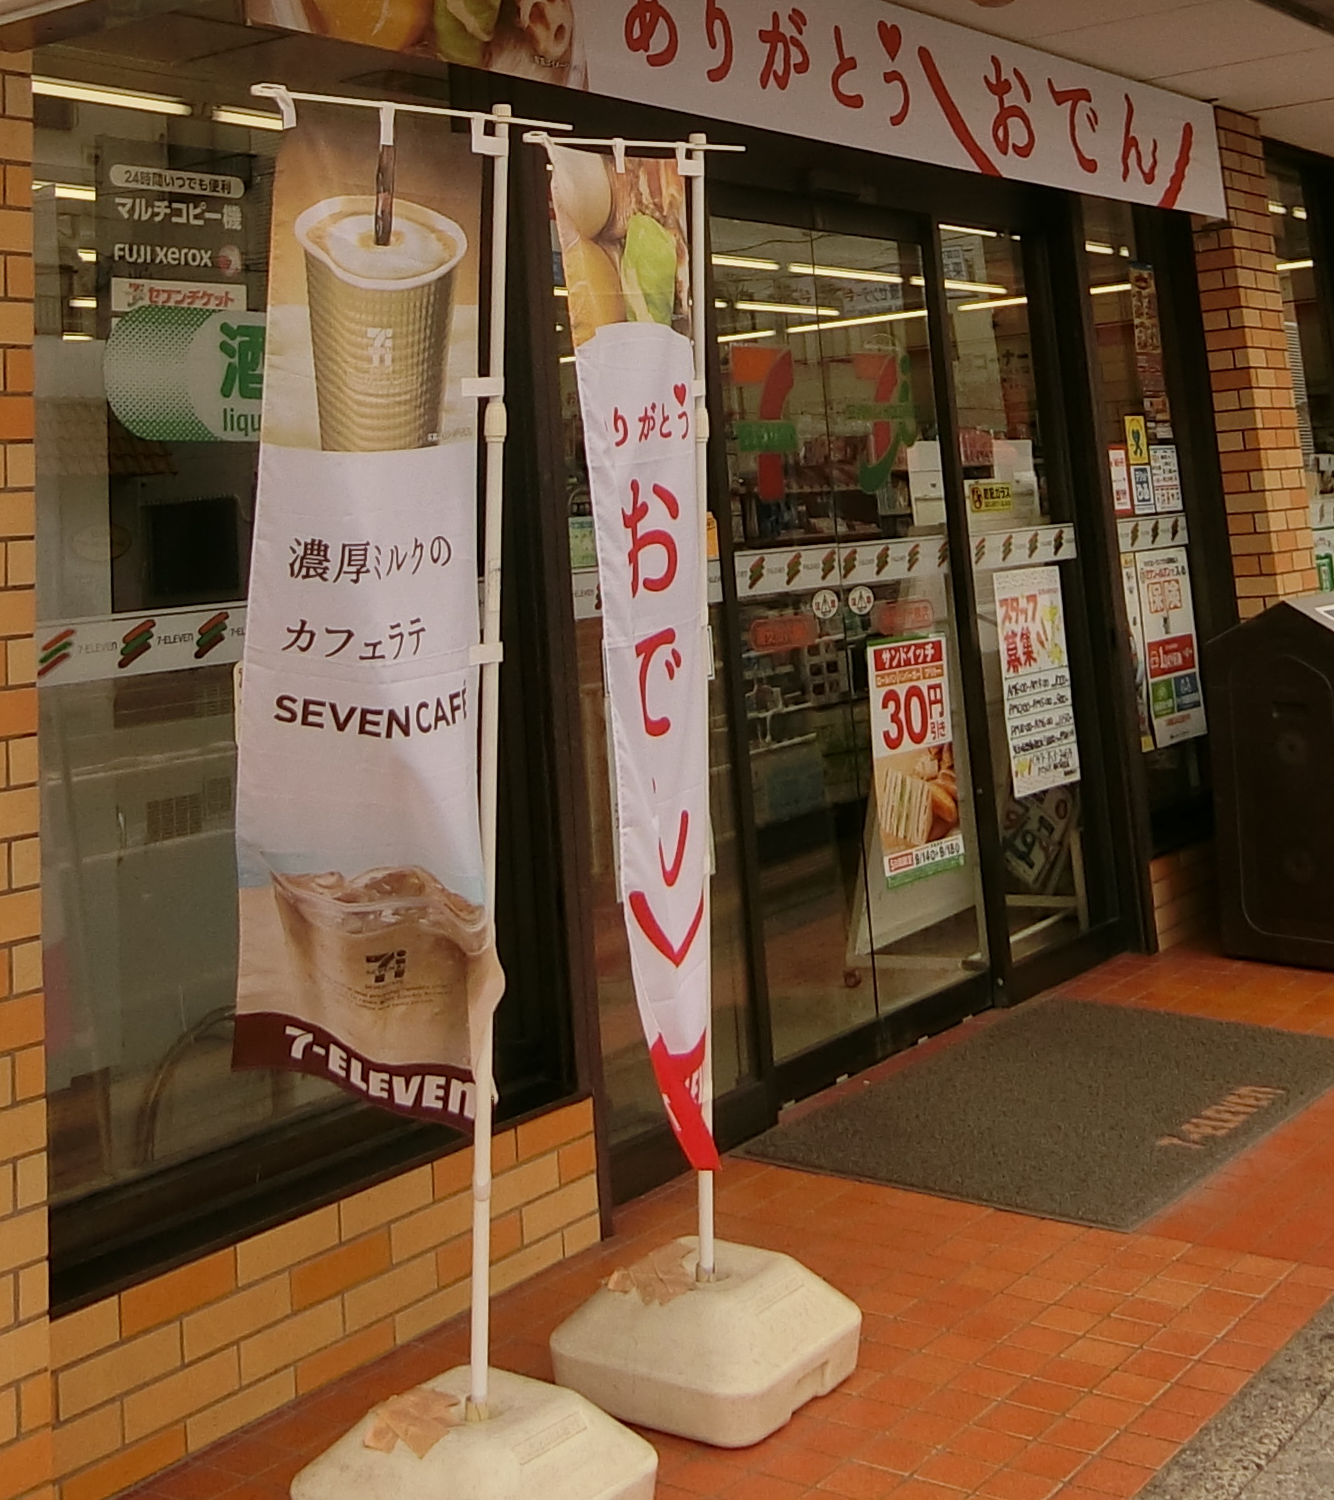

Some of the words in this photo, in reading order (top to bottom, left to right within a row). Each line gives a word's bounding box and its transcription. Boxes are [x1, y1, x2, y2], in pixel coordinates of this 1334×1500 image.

[984, 55, 1159, 185] おでん
[124, 169, 232, 195] 24時間いつでも便利
[115, 197, 242, 231] マルチコピー機
[114, 243, 152, 264] FUJI
[155, 246, 213, 268] xerox
[288, 535, 452, 585] 濃厚ミルクの
[281, 617, 426, 661] カフェラテ
